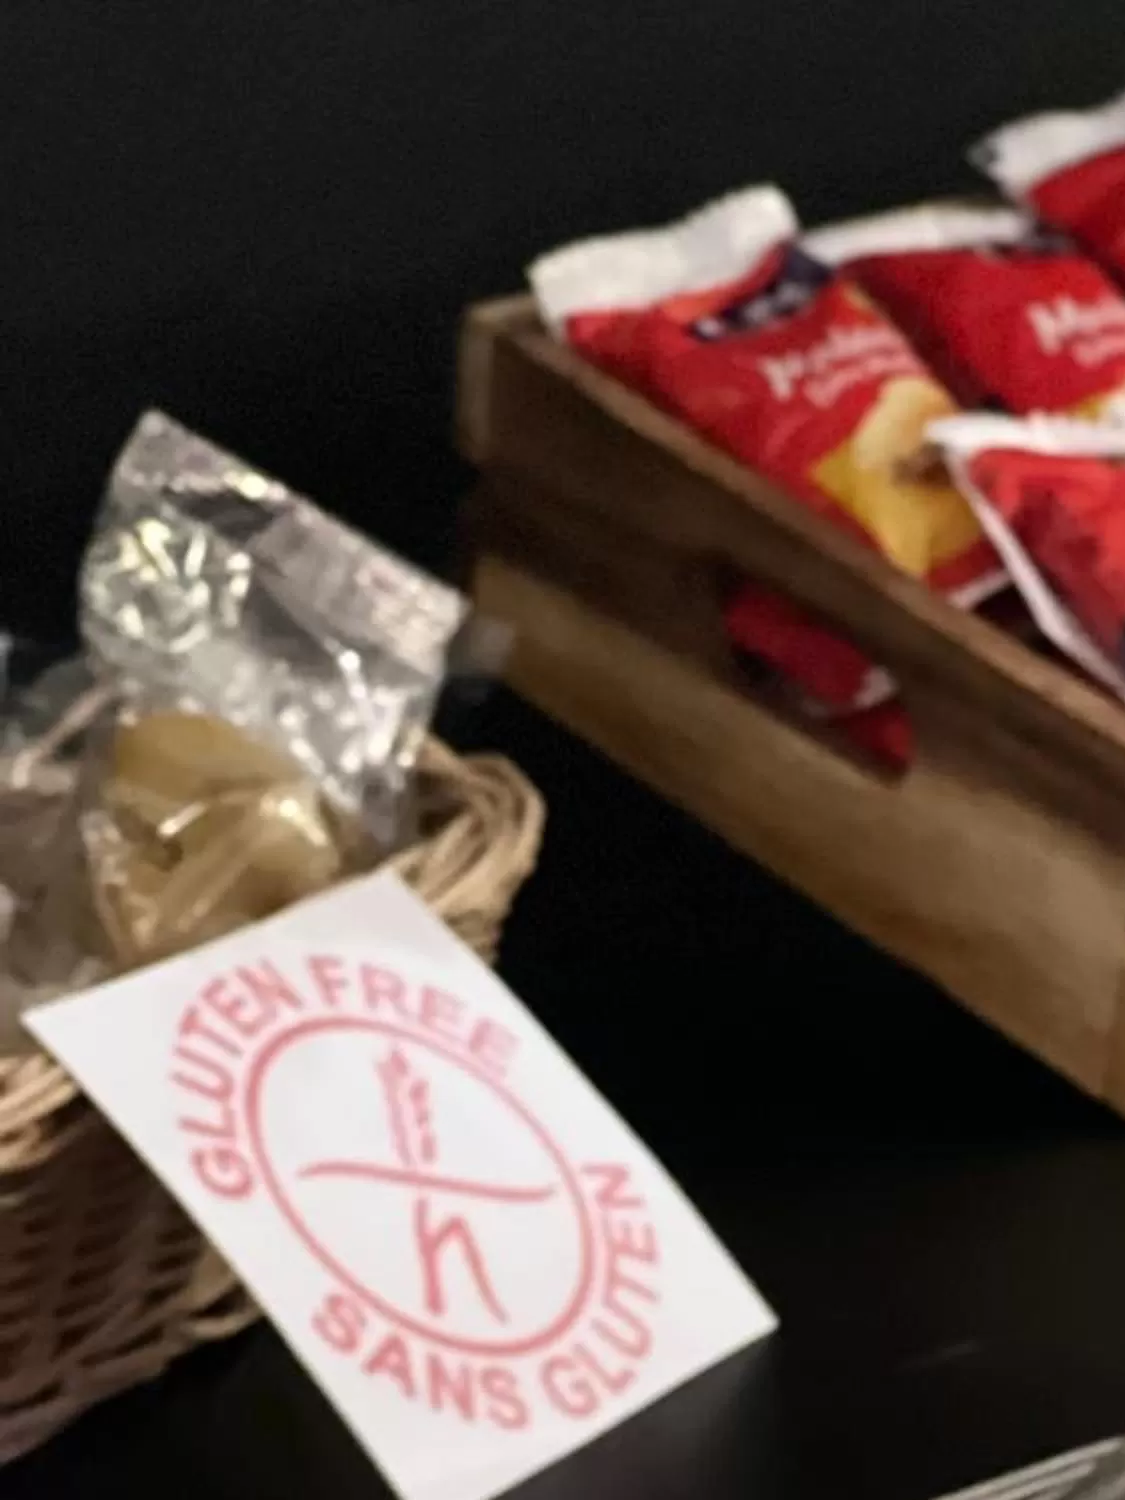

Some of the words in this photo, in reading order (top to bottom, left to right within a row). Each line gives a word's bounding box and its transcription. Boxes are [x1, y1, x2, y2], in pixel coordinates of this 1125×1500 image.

[171, 957, 306, 1200] GLUTEN
[306, 955, 520, 1074] FREE
[311, 1291, 530, 1431] SANS
[539, 1162, 661, 1420] GLUTEN
